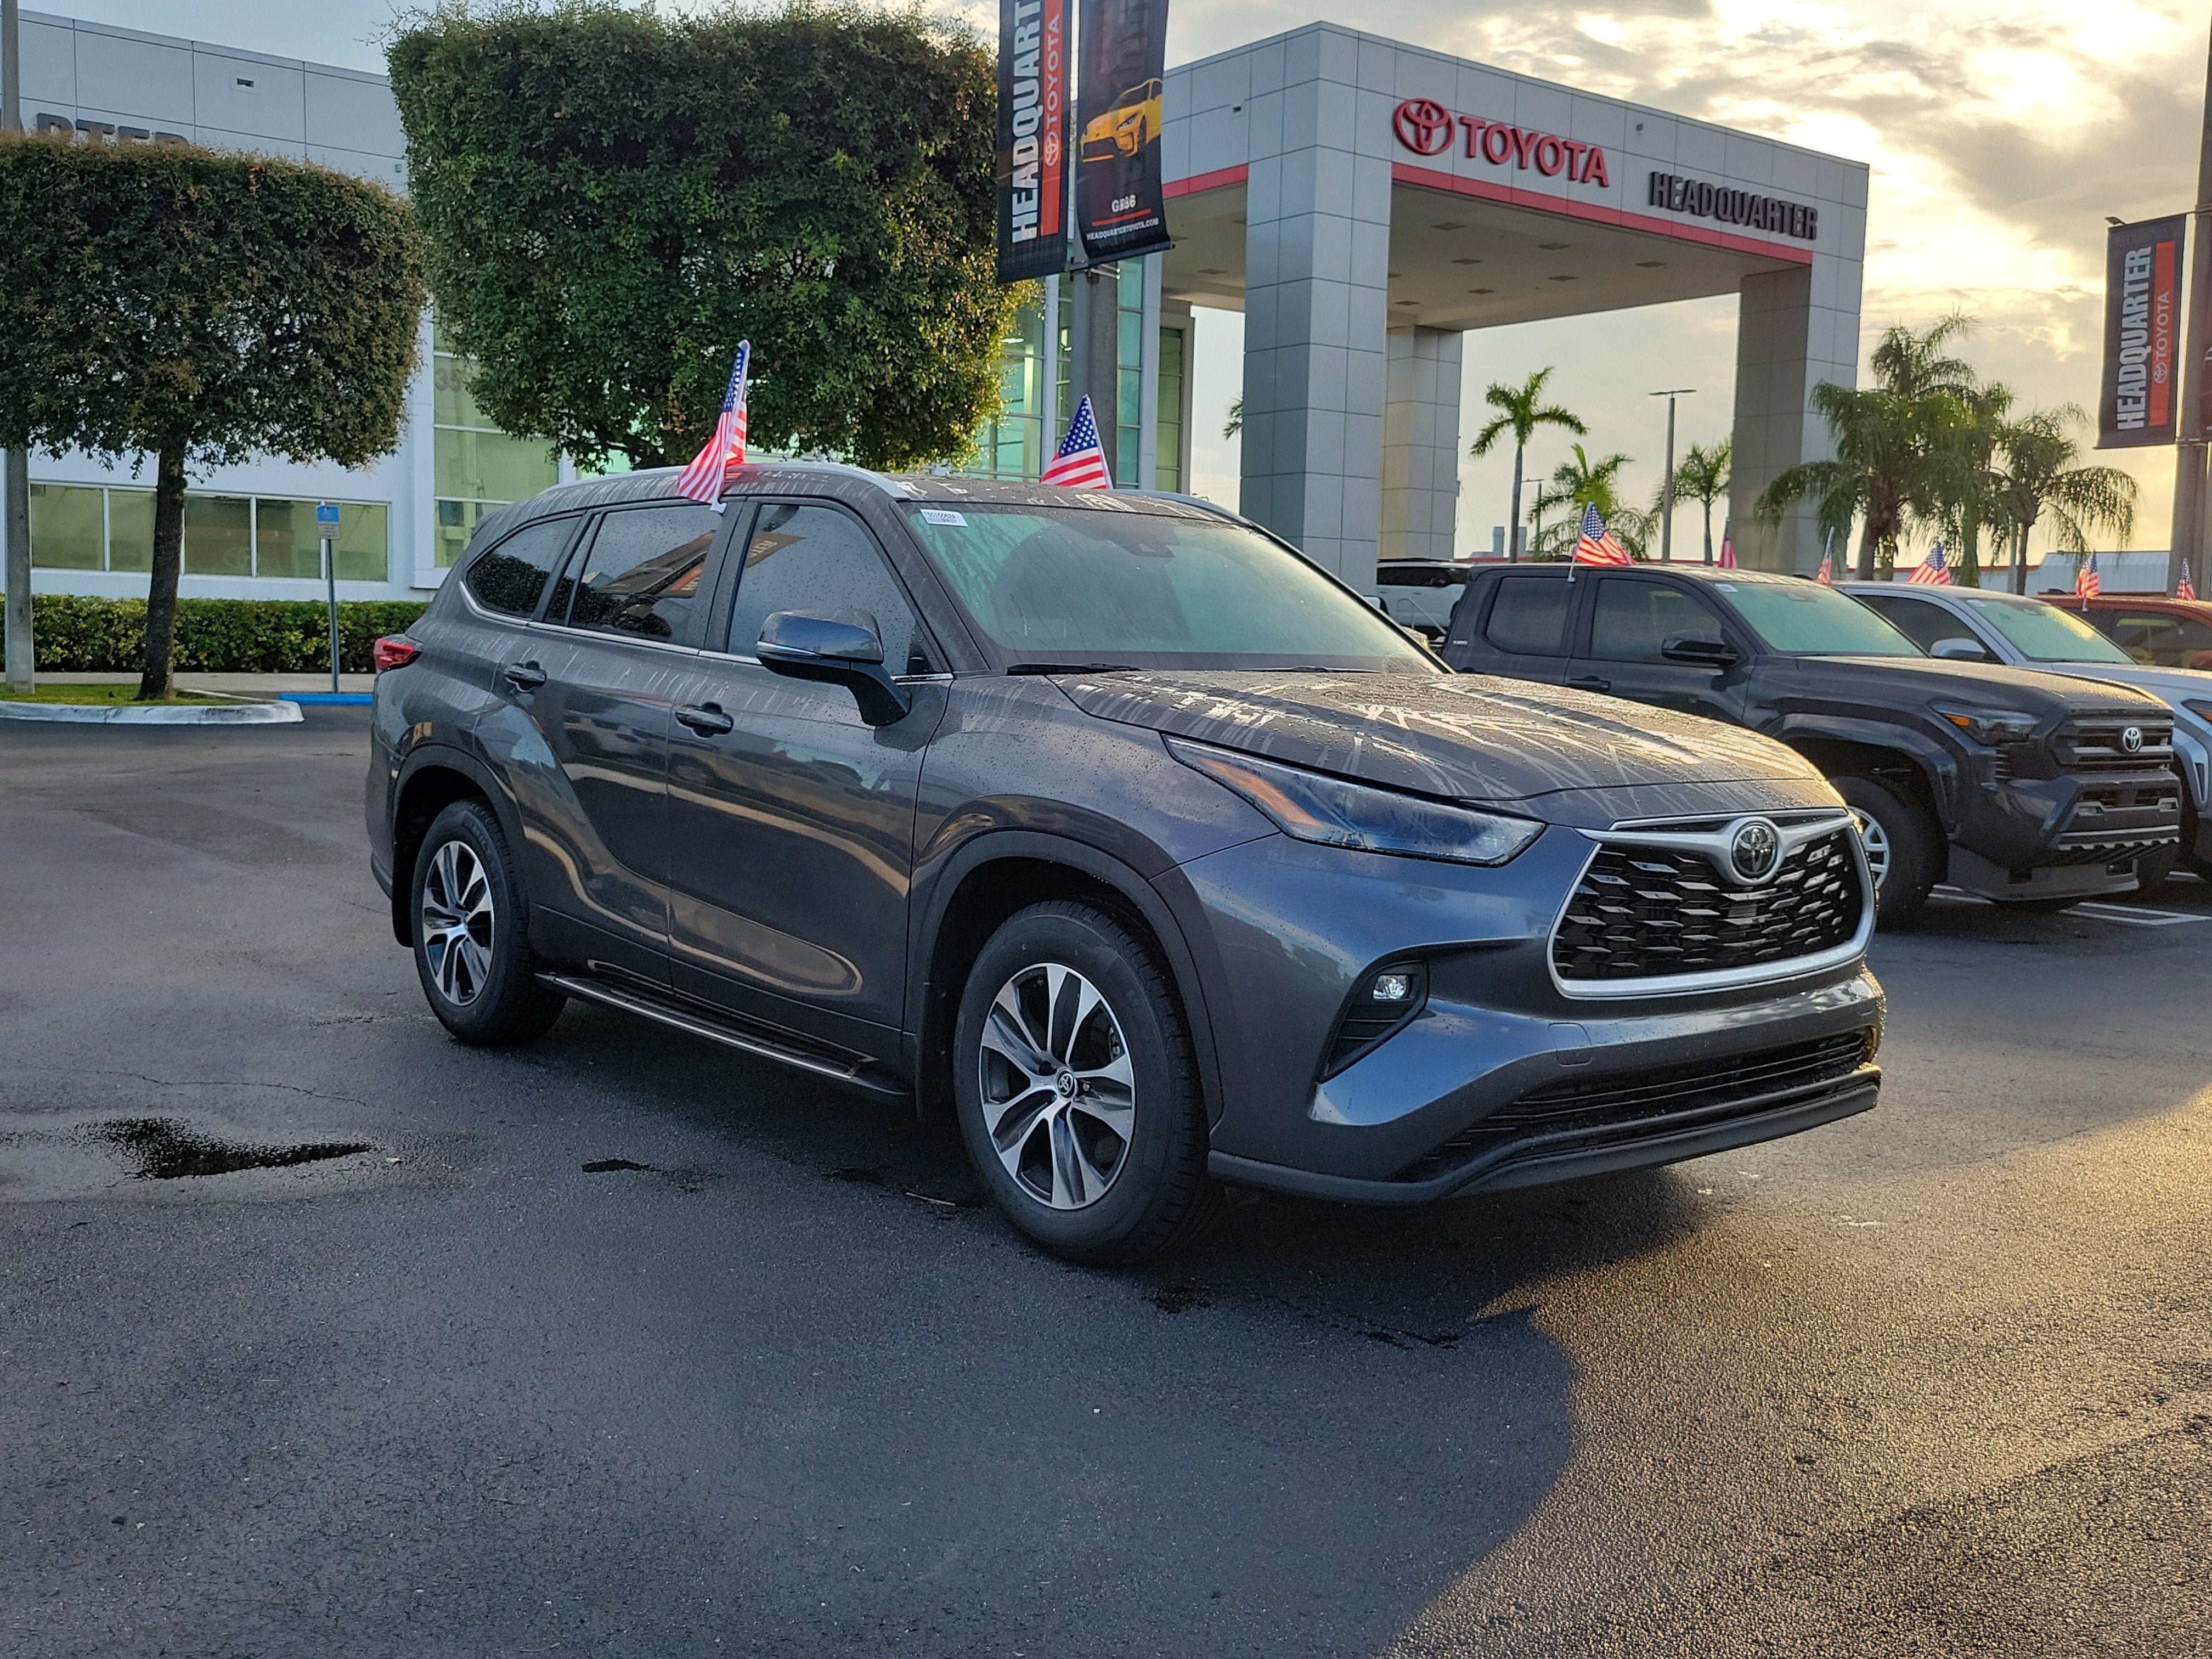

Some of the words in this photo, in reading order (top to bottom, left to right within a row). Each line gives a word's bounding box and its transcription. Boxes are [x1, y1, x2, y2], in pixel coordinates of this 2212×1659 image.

[1047, 14, 1059, 131] TOYOTA
[1460, 116, 1609, 188] TOYOTA
[1649, 171, 1818, 240] HEADQUARTER
[2117, 246, 2151, 431] HEADQUARTER
[2154, 291, 2170, 360] TOYOTA
